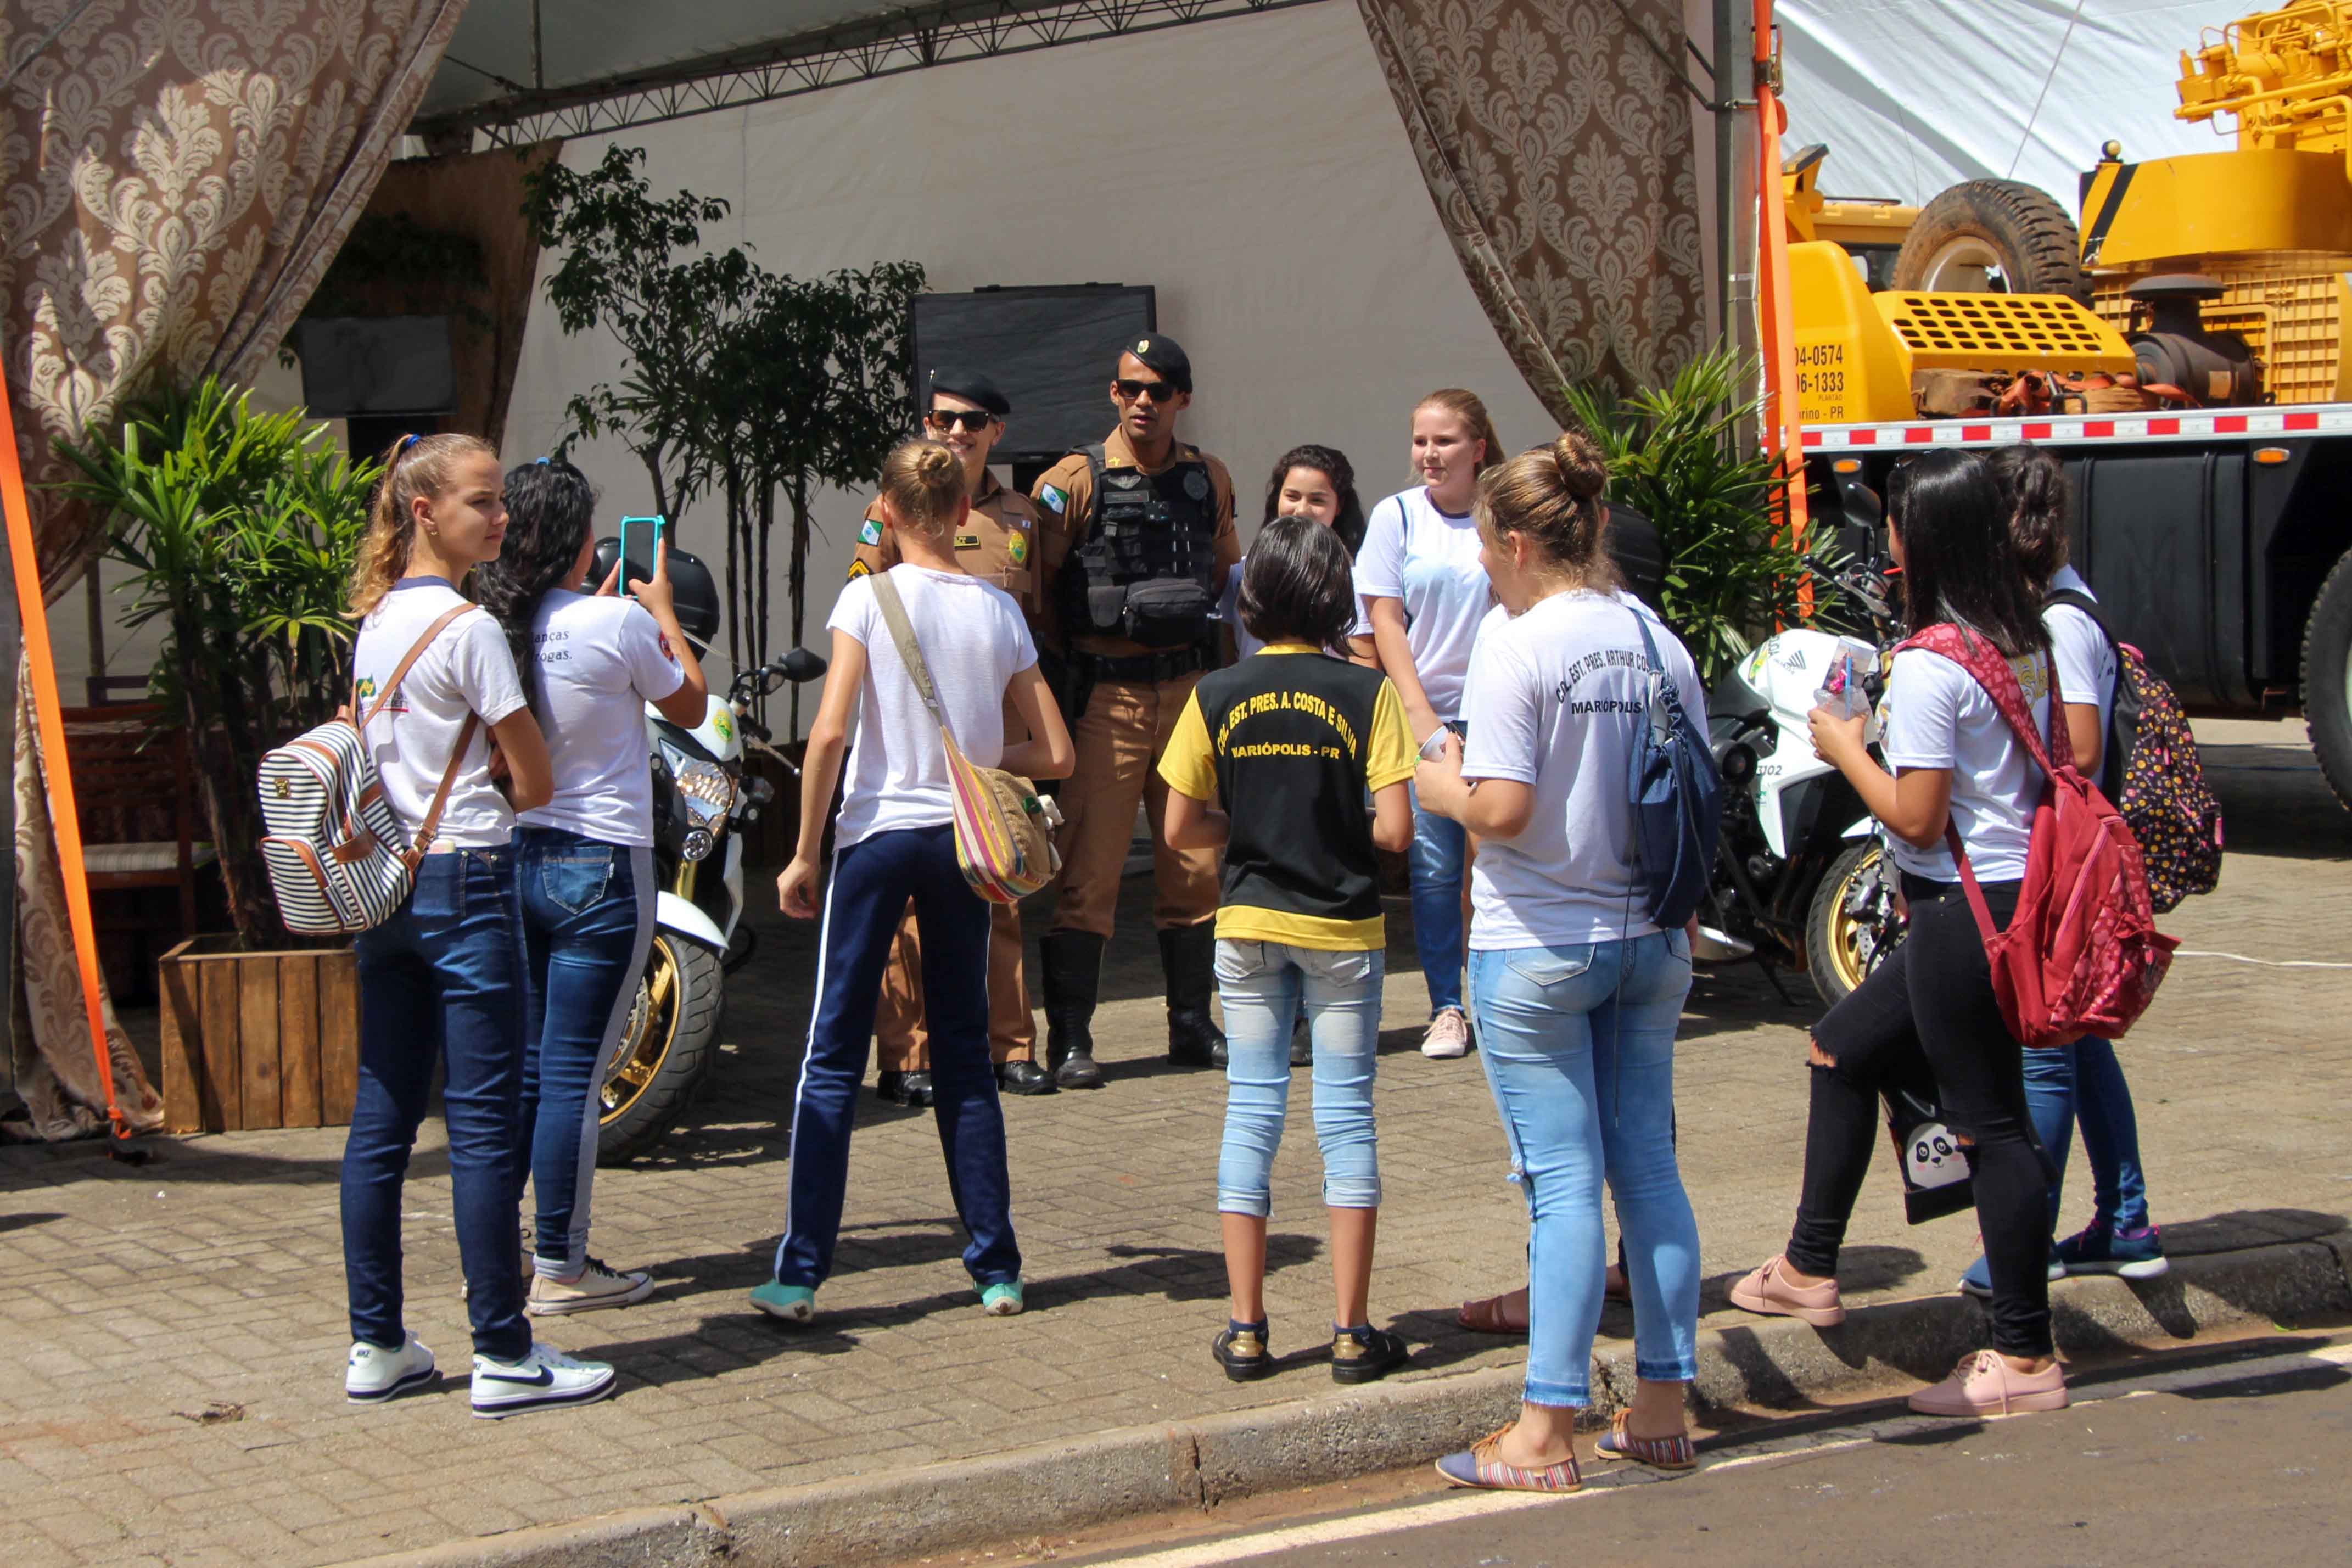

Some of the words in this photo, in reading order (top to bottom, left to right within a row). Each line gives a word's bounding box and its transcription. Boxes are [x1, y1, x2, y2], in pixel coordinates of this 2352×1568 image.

[1830, 405, 1844, 418] PR
[534, 631, 569, 643] anças
[534, 650, 572, 663] rogas.
[1556, 680, 1572, 703] COL.
[1569, 660, 1587, 684] EST.
[1583, 651, 1606, 673] PRES.
[1605, 650, 1634, 668] ARTHUR
[1229, 701, 1248, 730] EST.
[1250, 692, 1279, 715] PRES.
[1281, 691, 1291, 709] A.
[1293, 691, 1326, 720] COSTA
[1328, 705, 1335, 726] E
[1336, 714, 1357, 760] SILVA
[1321, 746, 1340, 759] PR
